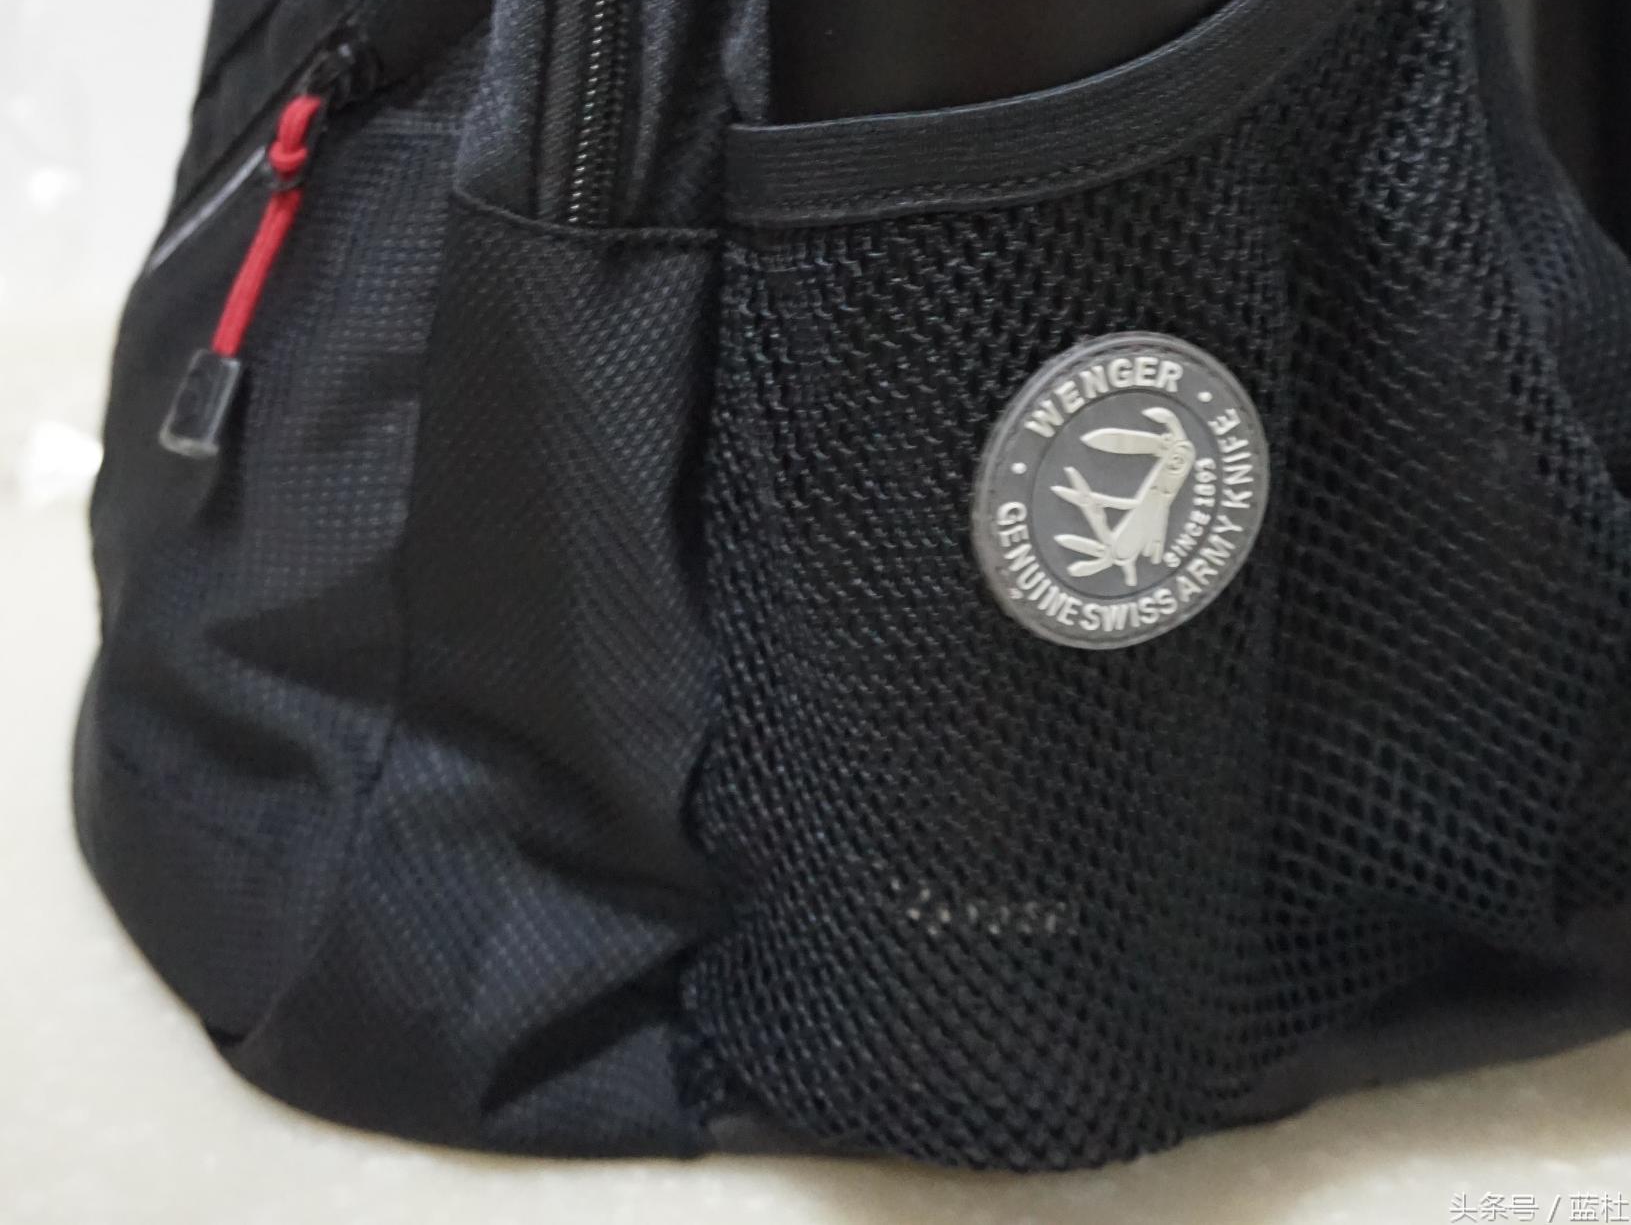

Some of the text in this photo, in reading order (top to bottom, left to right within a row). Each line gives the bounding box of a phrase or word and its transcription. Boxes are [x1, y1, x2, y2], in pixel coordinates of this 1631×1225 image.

[1024, 356, 1184, 438] WENGER
[1207, 408, 1255, 509] KNIFE
[1163, 510, 1212, 569] SINCE
[1176, 514, 1243, 603] ARMY
[1079, 588, 1178, 632] SWISS
